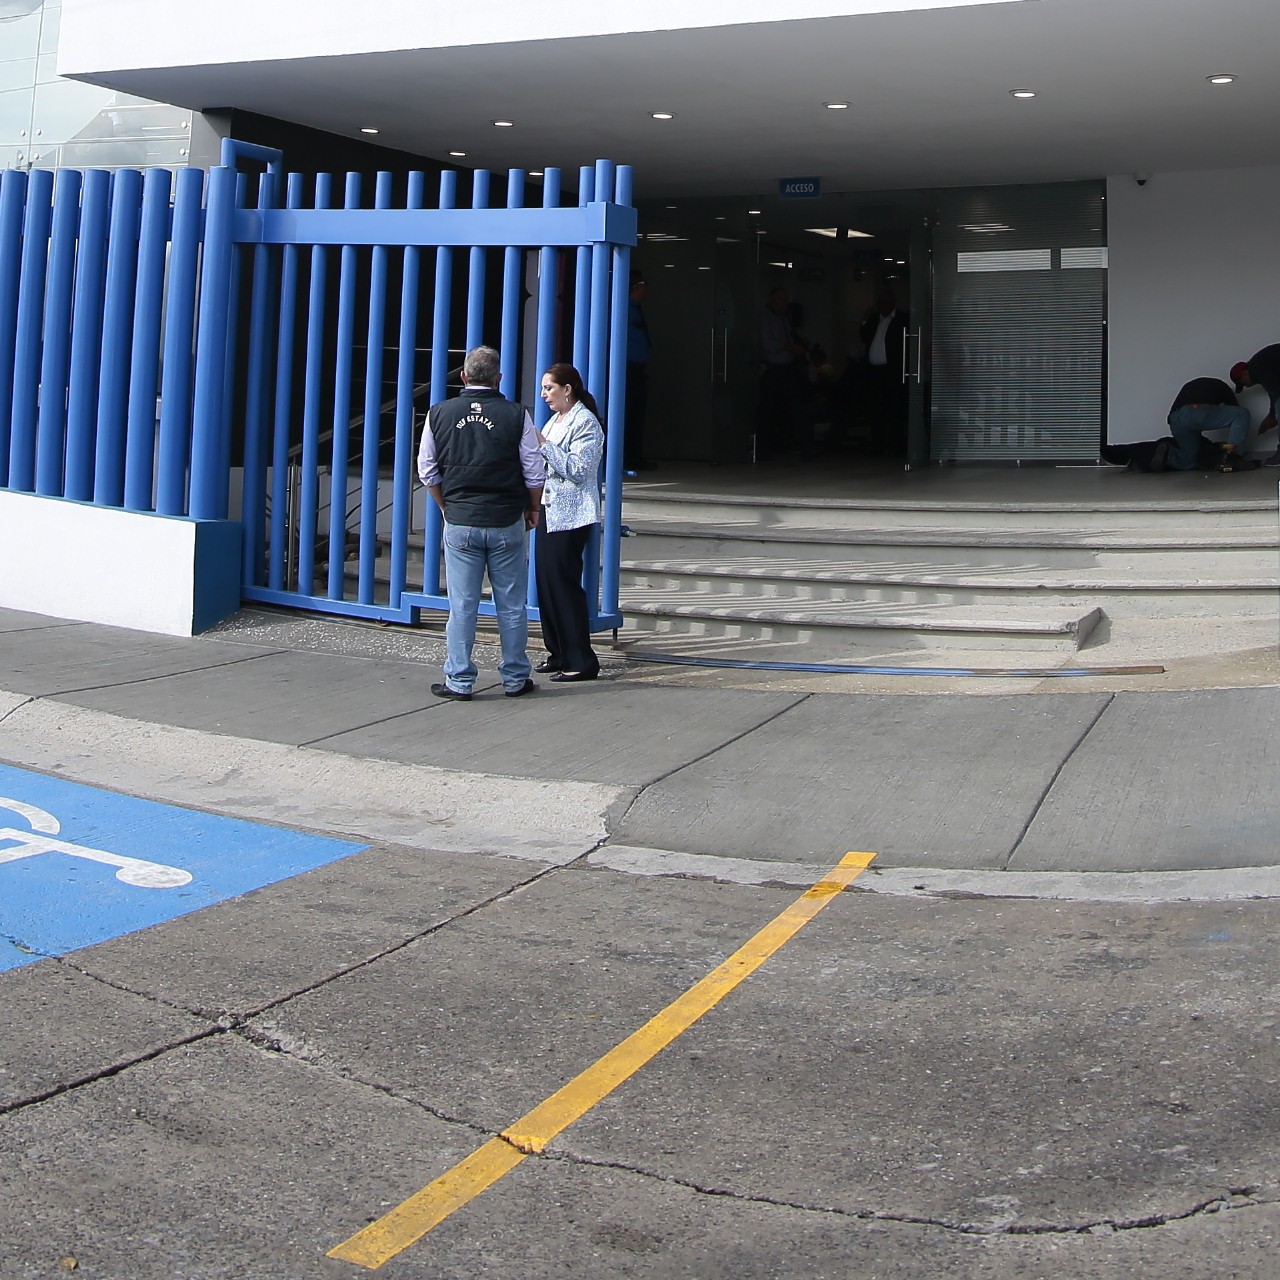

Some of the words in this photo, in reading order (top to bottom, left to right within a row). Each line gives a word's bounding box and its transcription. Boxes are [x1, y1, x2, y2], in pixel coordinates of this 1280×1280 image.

[786, 184, 814, 192] ACCESO
[456, 418, 466, 429] DIF
[467, 415, 494, 430] ESTATAL
